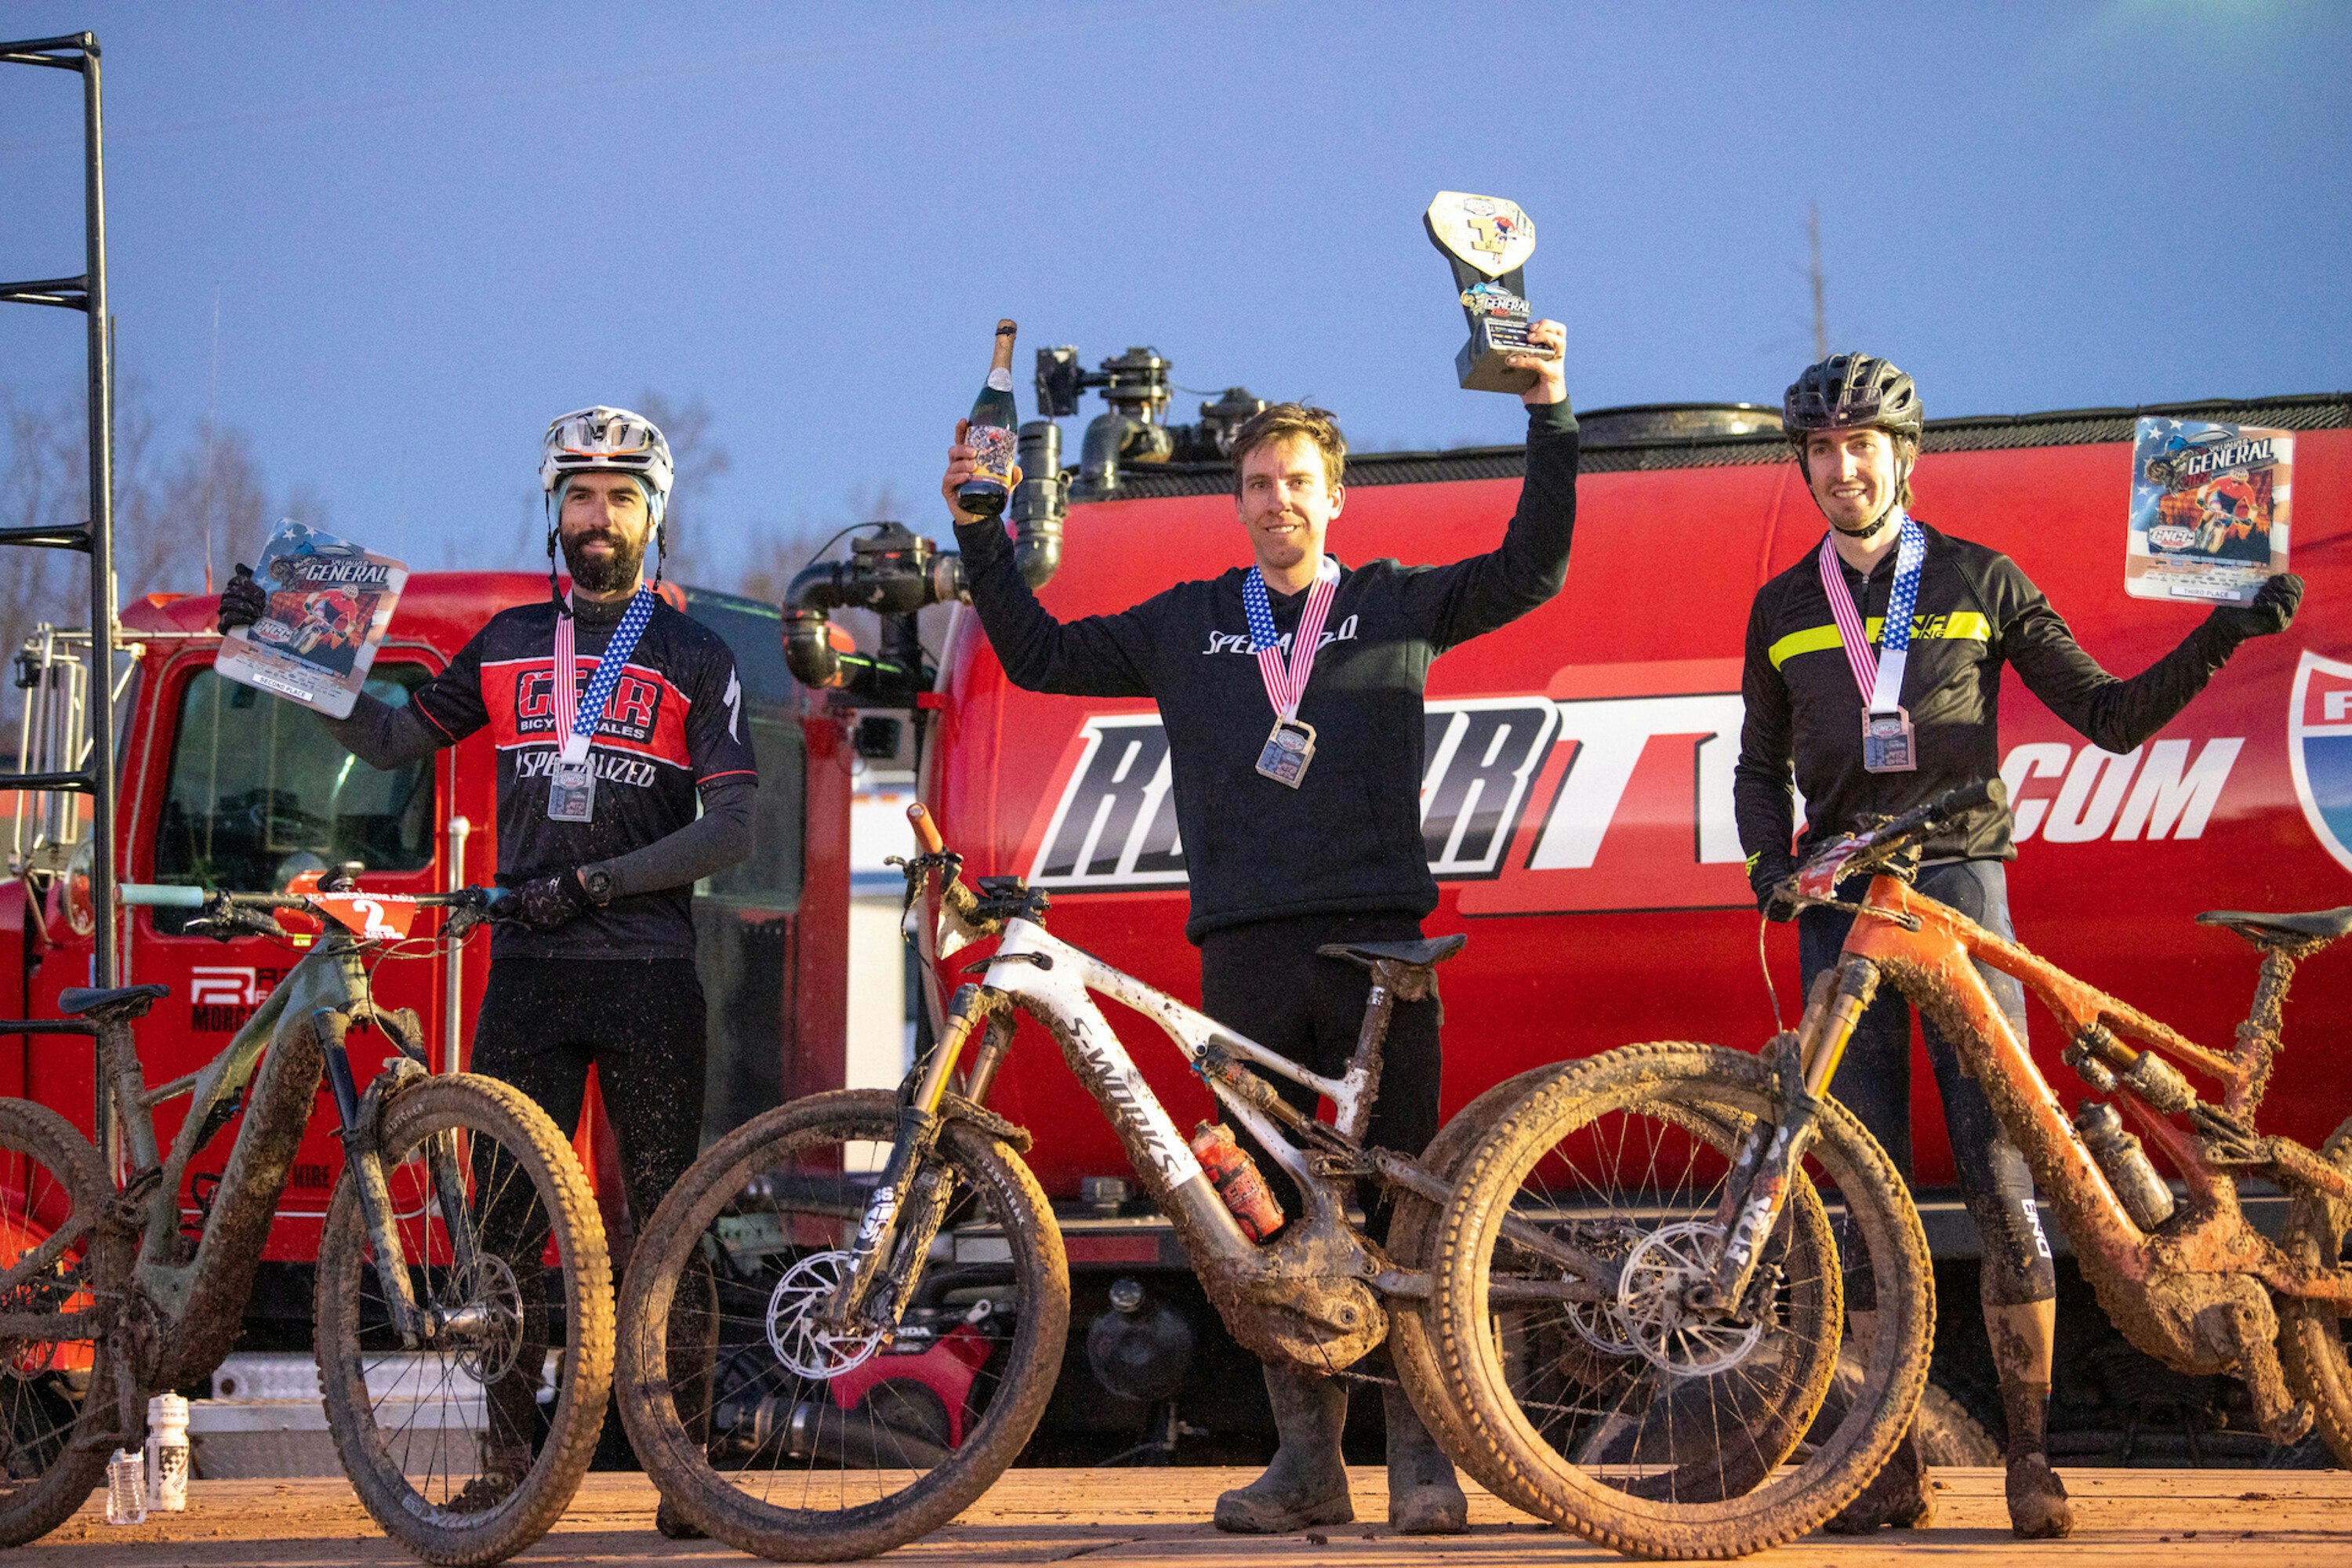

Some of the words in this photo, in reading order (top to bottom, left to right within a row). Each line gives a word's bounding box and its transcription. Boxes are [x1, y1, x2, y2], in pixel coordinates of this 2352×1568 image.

[1484, 298, 1531, 314] GENERAL
[2188, 439, 2271, 475] GENERAL
[2151, 530, 2194, 543] GNCC
[305, 564, 387, 583] GENERAL
[252, 620, 292, 639] GNCC
[260, 676, 285, 689] SECOND
[285, 686, 306, 697] PLACE
[593, 725, 645, 740] ALES
[351, 900, 395, 933] 2
[1061, 1017, 1181, 1174] S-WORKS
[292, 1164, 331, 1189] HIRE
[982, 1158, 1007, 1189] FAST
[1004, 1188, 1025, 1227] TRAK
[1725, 1195, 1773, 1266] FOX
